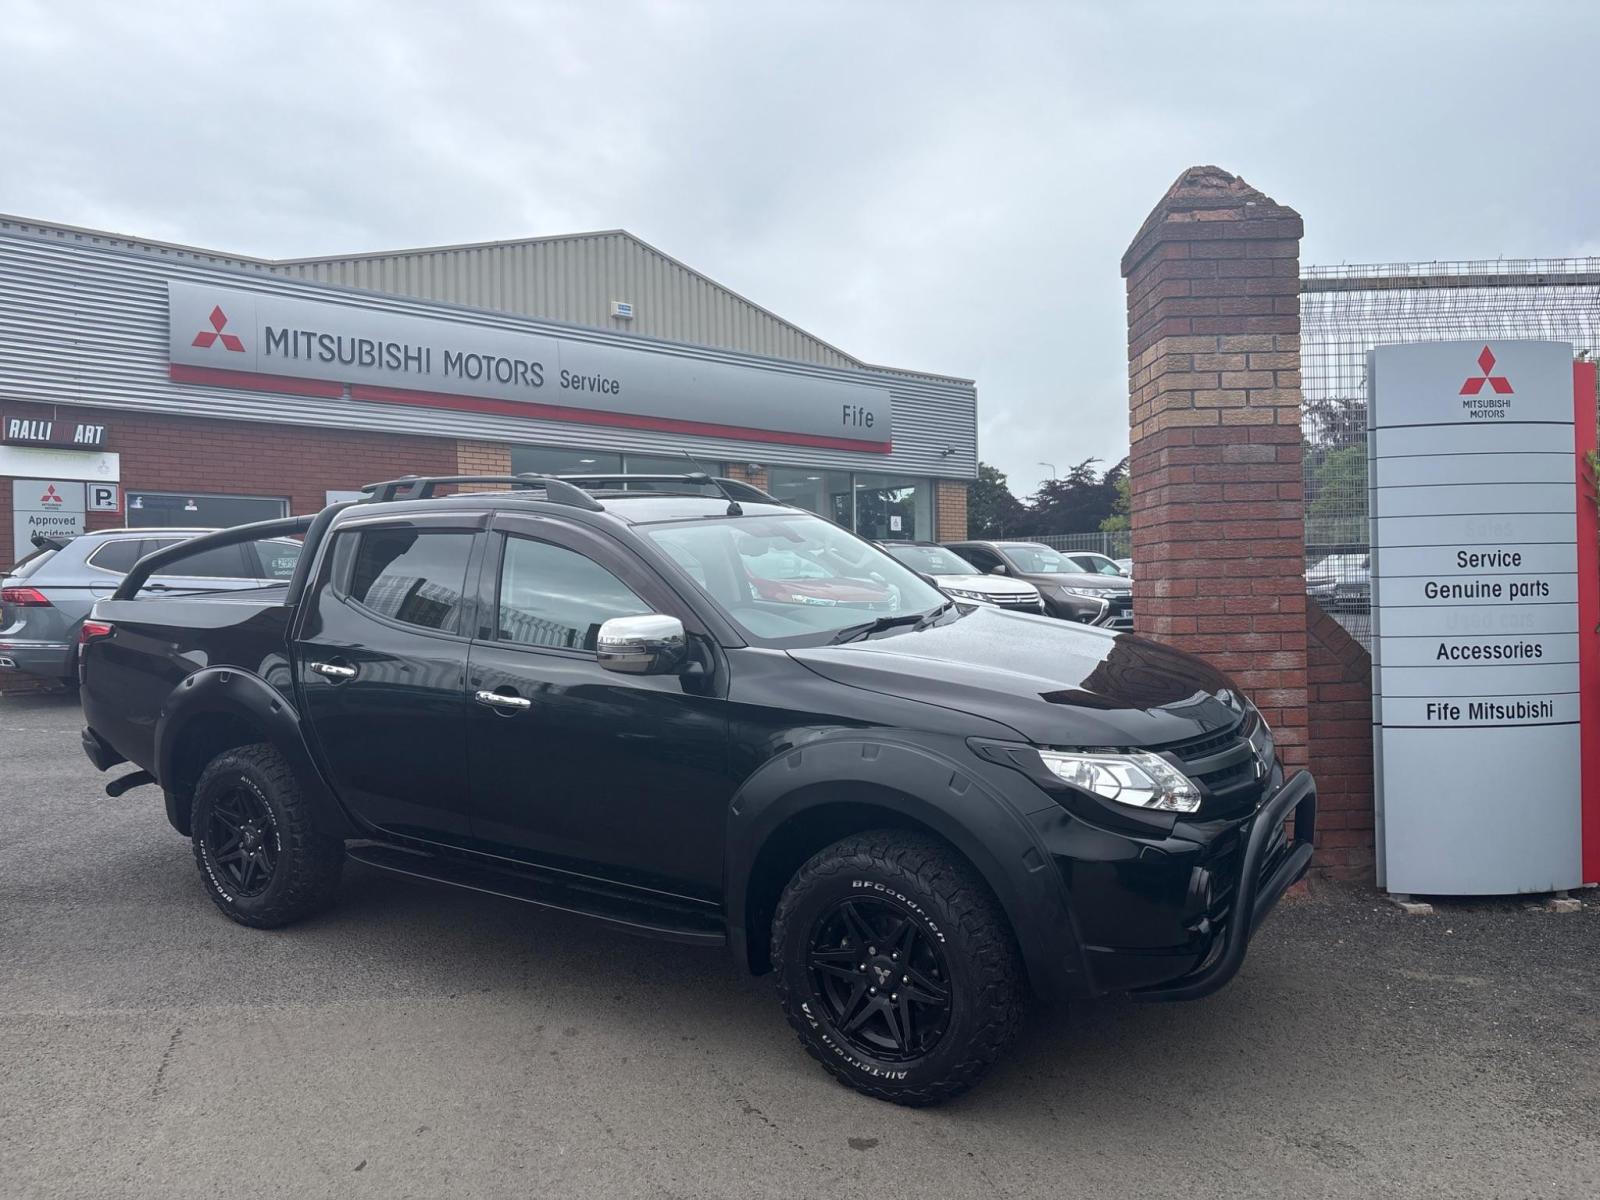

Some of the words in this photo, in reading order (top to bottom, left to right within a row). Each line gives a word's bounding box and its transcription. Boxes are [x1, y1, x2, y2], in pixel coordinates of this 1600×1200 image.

[265, 326, 431, 373] MITSUBISHI
[444, 350, 545, 388] MOTORS
[560, 369, 620, 395] Service
[1462, 399, 1511, 409] MITSUBISHI
[1470, 409, 1505, 419] MOTORS
[843, 405, 874, 428] Fife
[9, 419, 52, 441] RALLI
[73, 424, 104, 444] ART
[95, 488, 112, 506] P
[28, 515, 76, 527] Approved
[1456, 549, 1522, 568] Service
[1424, 580, 1502, 599] Genuine
[1509, 580, 1550, 601] parts
[1436, 641, 1543, 661] Accessories
[1426, 703, 1461, 720] Fife
[1468, 700, 1553, 720] Mitsubishi
